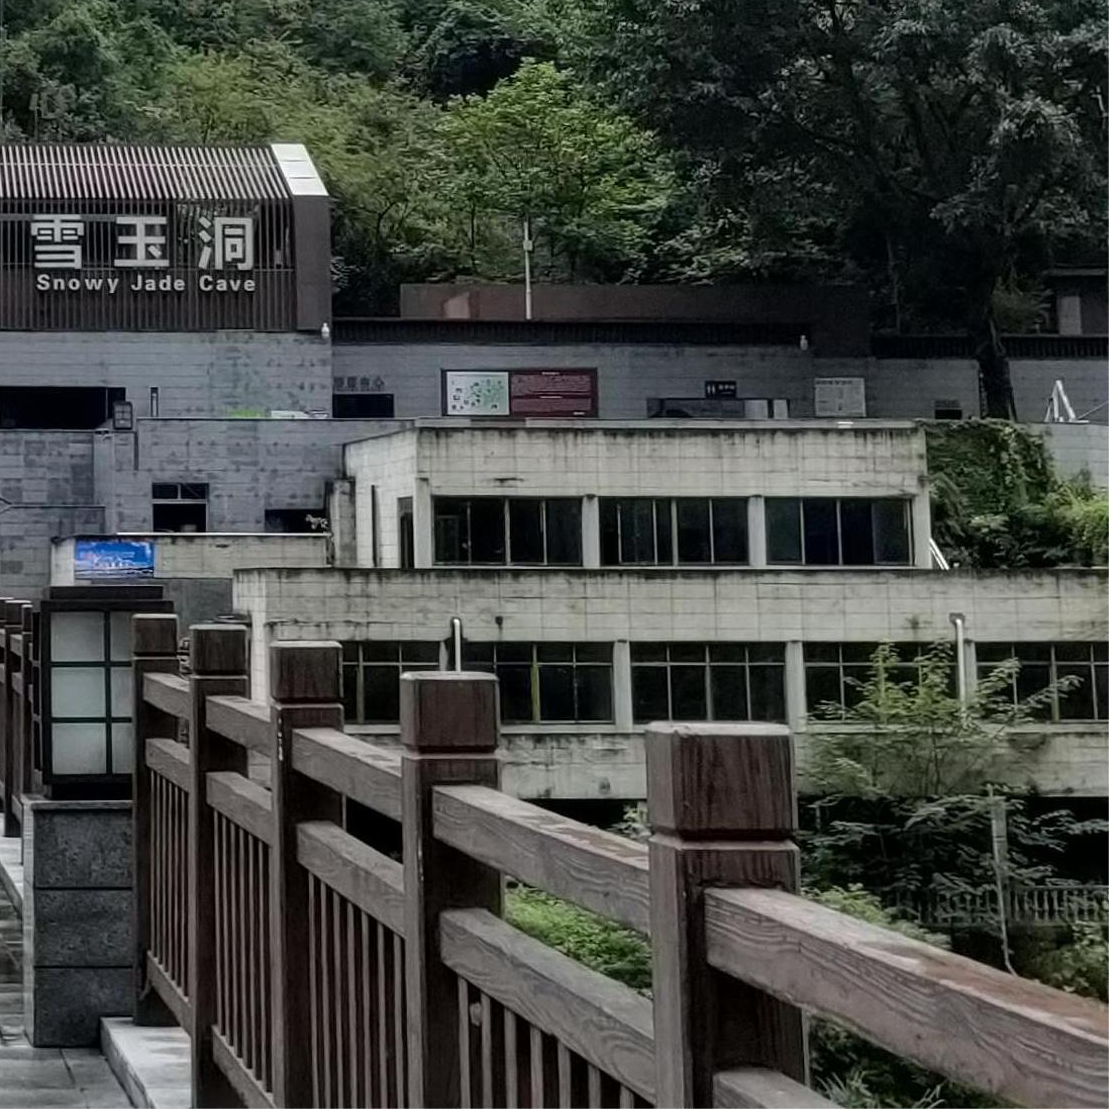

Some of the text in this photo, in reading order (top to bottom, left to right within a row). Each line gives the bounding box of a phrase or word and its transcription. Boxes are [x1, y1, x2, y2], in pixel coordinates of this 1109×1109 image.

[30, 214, 254, 270] 雪玉洞
[36, 274, 256, 294] Snowy Jade Cave
